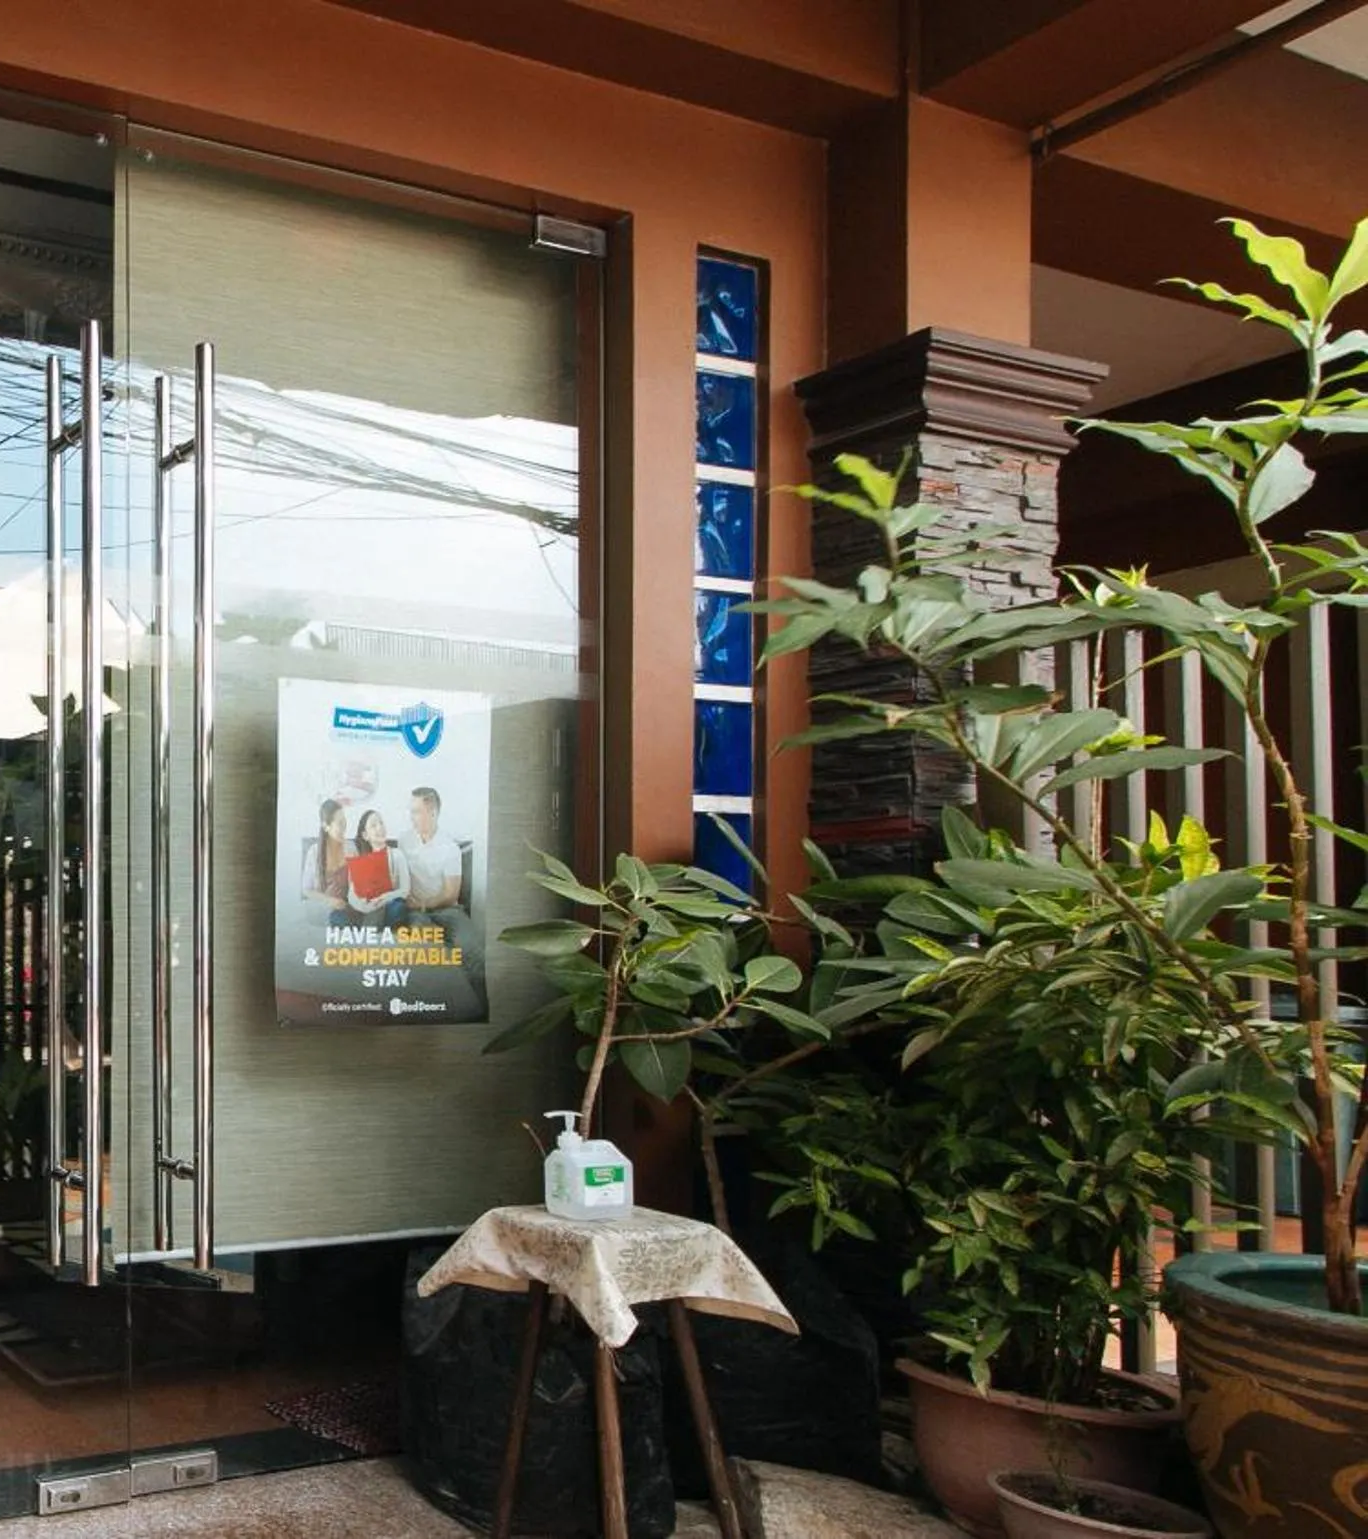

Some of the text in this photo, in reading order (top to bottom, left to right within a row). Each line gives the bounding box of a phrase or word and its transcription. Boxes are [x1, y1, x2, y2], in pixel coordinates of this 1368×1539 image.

[325, 926, 445, 945] HAVE A SAFE
[304, 947, 463, 966] & COMFORTABLE
[361, 969, 412, 988] STAY
